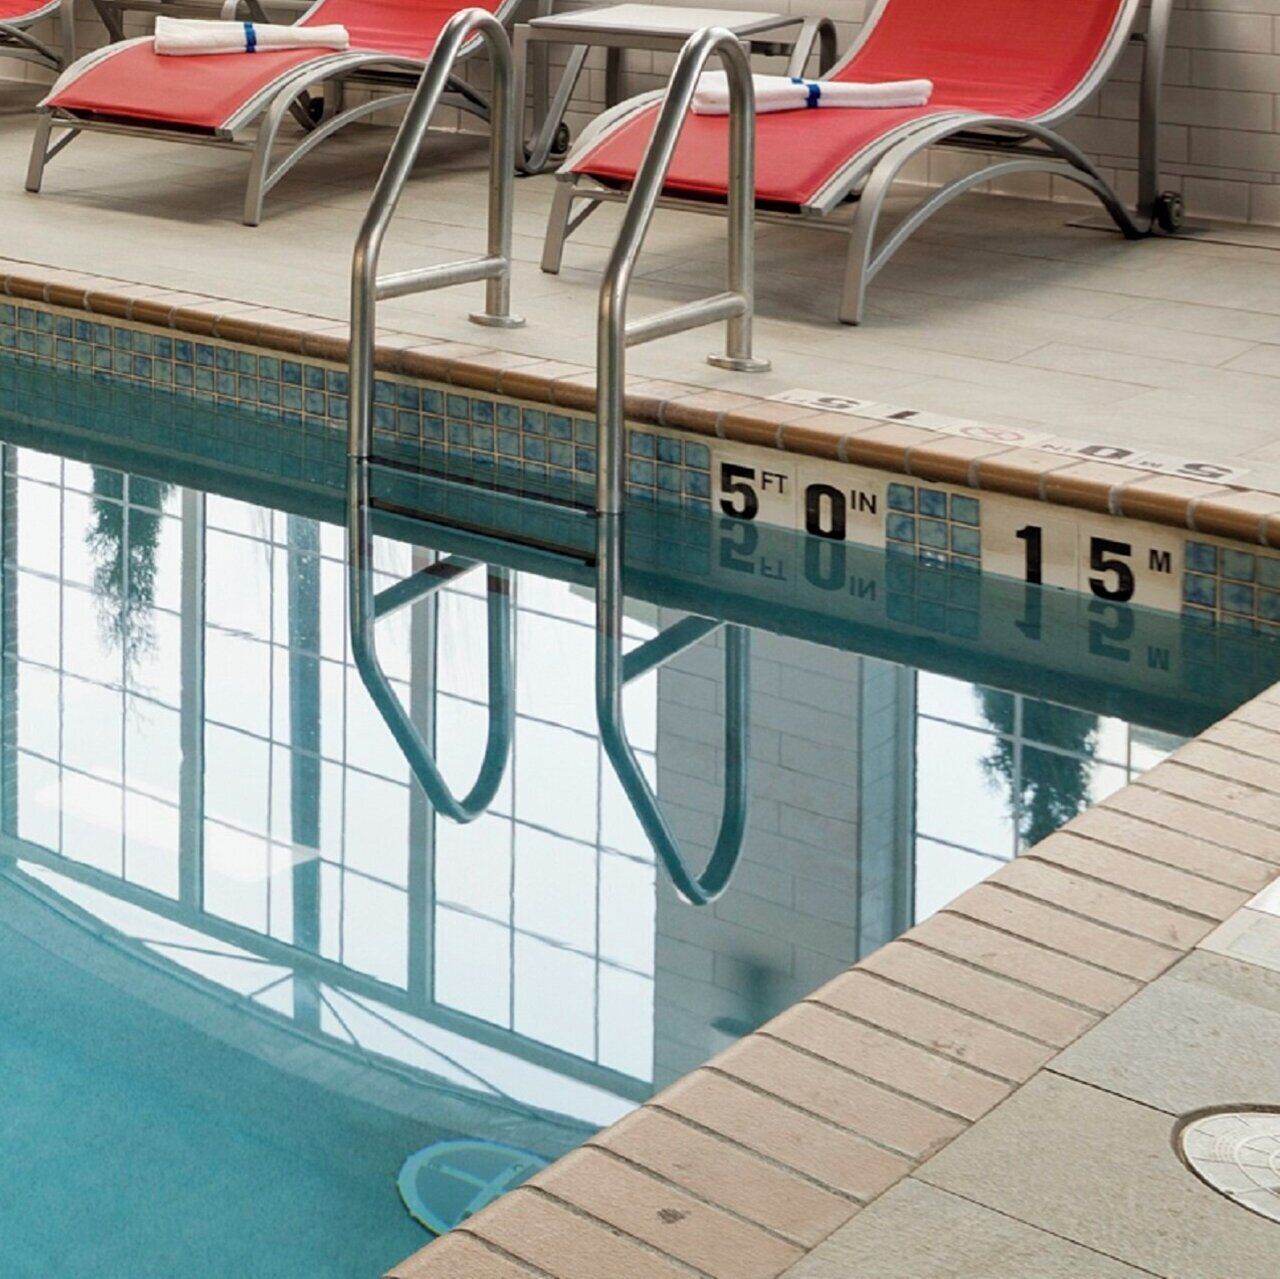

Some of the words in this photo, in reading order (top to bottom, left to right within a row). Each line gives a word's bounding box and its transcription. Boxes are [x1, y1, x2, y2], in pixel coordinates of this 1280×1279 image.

[720, 462, 759, 520] 5
[761, 471, 788, 493] FT
[805, 484, 846, 540] 0
[850, 490, 876, 514] IN
[1149, 549, 1171, 573] M
